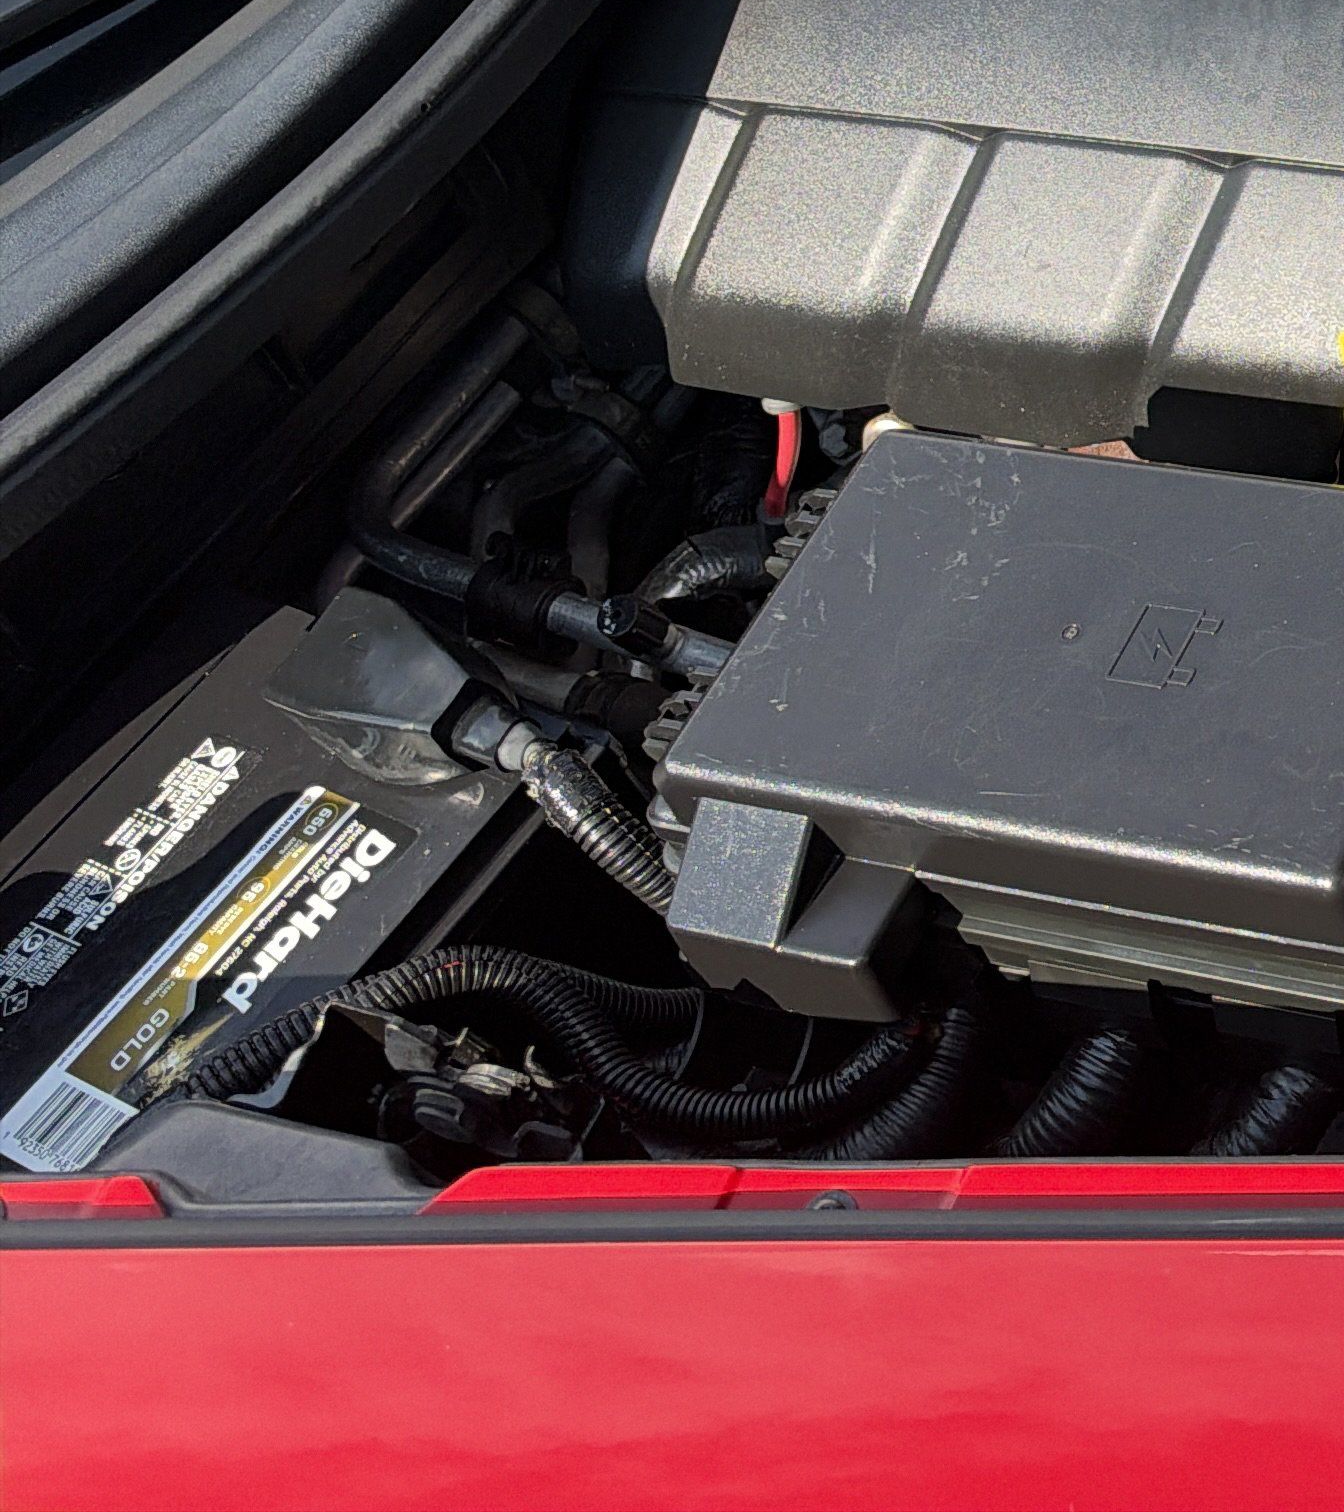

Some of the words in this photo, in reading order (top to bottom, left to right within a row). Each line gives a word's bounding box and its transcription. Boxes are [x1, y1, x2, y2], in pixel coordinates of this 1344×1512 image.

[254, 804, 304, 855] WARNING:
[301, 807, 334, 836] 650
[324, 818, 360, 854] Advance
[84, 780, 230, 931] DANGER/POISON
[305, 854, 329, 876] Auto
[86, 870, 105, 887] CAN
[282, 874, 310, 899] Parts,
[64, 886, 91, 911] CAUSE
[71, 896, 92, 915] ACID
[45, 907, 60, 920] OR
[62, 899, 99, 935] SULFURIC
[222, 832, 397, 1015] DieHard
[251, 898, 288, 934] Raleigh,
[16, 926, 30, 938] DO
[239, 933, 256, 947] NC
[4, 955, 27, 977] READ
[14, 950, 45, 981] MEDICAL
[52, 946, 77, 969] FLUSH
[169, 941, 210, 979] 86-2
[107, 1008, 171, 1070] GOLD
